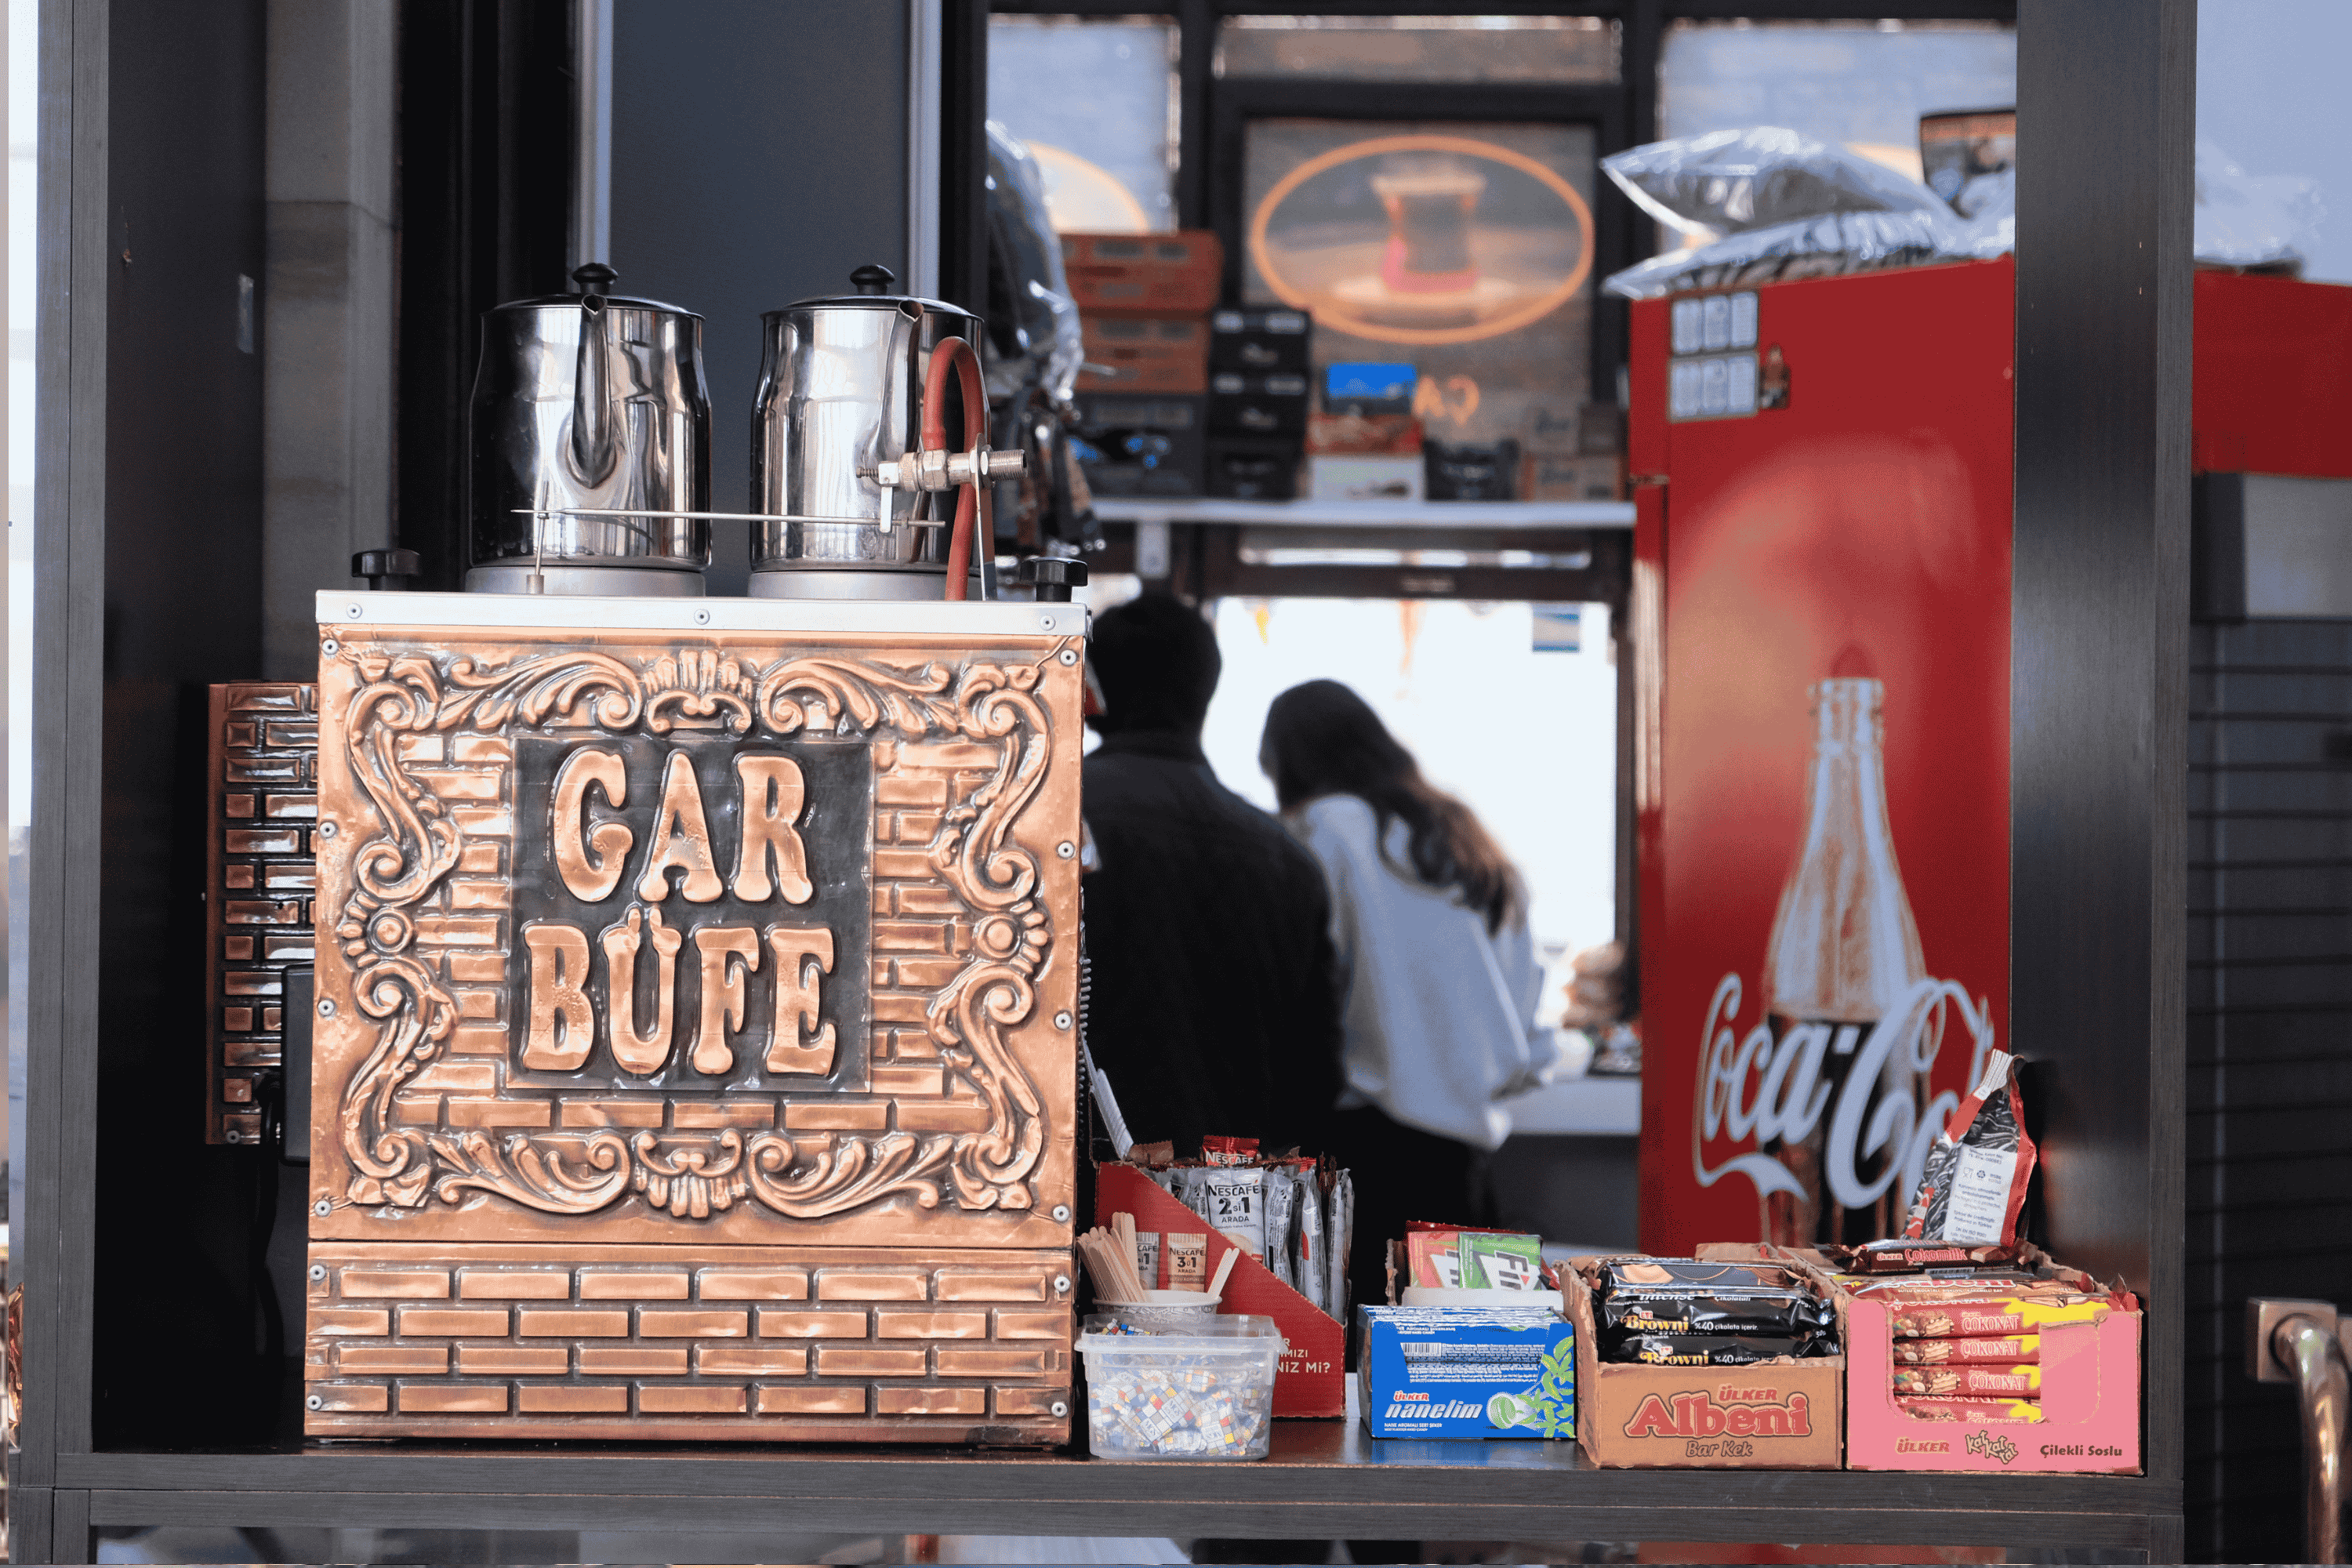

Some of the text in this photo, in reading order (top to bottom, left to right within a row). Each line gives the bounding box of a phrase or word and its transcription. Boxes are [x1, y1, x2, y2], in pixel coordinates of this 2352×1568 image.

[551, 746, 814, 905] GAR
[521, 906, 837, 1076] BÜFE
[1620, 1315, 1690, 1333] Browni
[1694, 1321, 1714, 1331] %40
[1962, 1315, 2020, 1334] ÇOKONAT
[1715, 1354, 1733, 1364] %40
[1961, 1341, 2019, 1359] ÇOKONAT
[1969, 1374, 2026, 1392] ÇOKONAT
[1393, 1389, 1429, 1402] ÜLKER
[1718, 1385, 1777, 1402] ÜLKER
[1385, 1399, 1483, 1418] nanelim
[1624, 1391, 1813, 1439] Albeni
[1686, 1440, 1753, 1457] Bar Kek
[1895, 1436, 1951, 1454] ÜLKER
[2040, 1444, 2123, 1458] Çilekli Soslu
